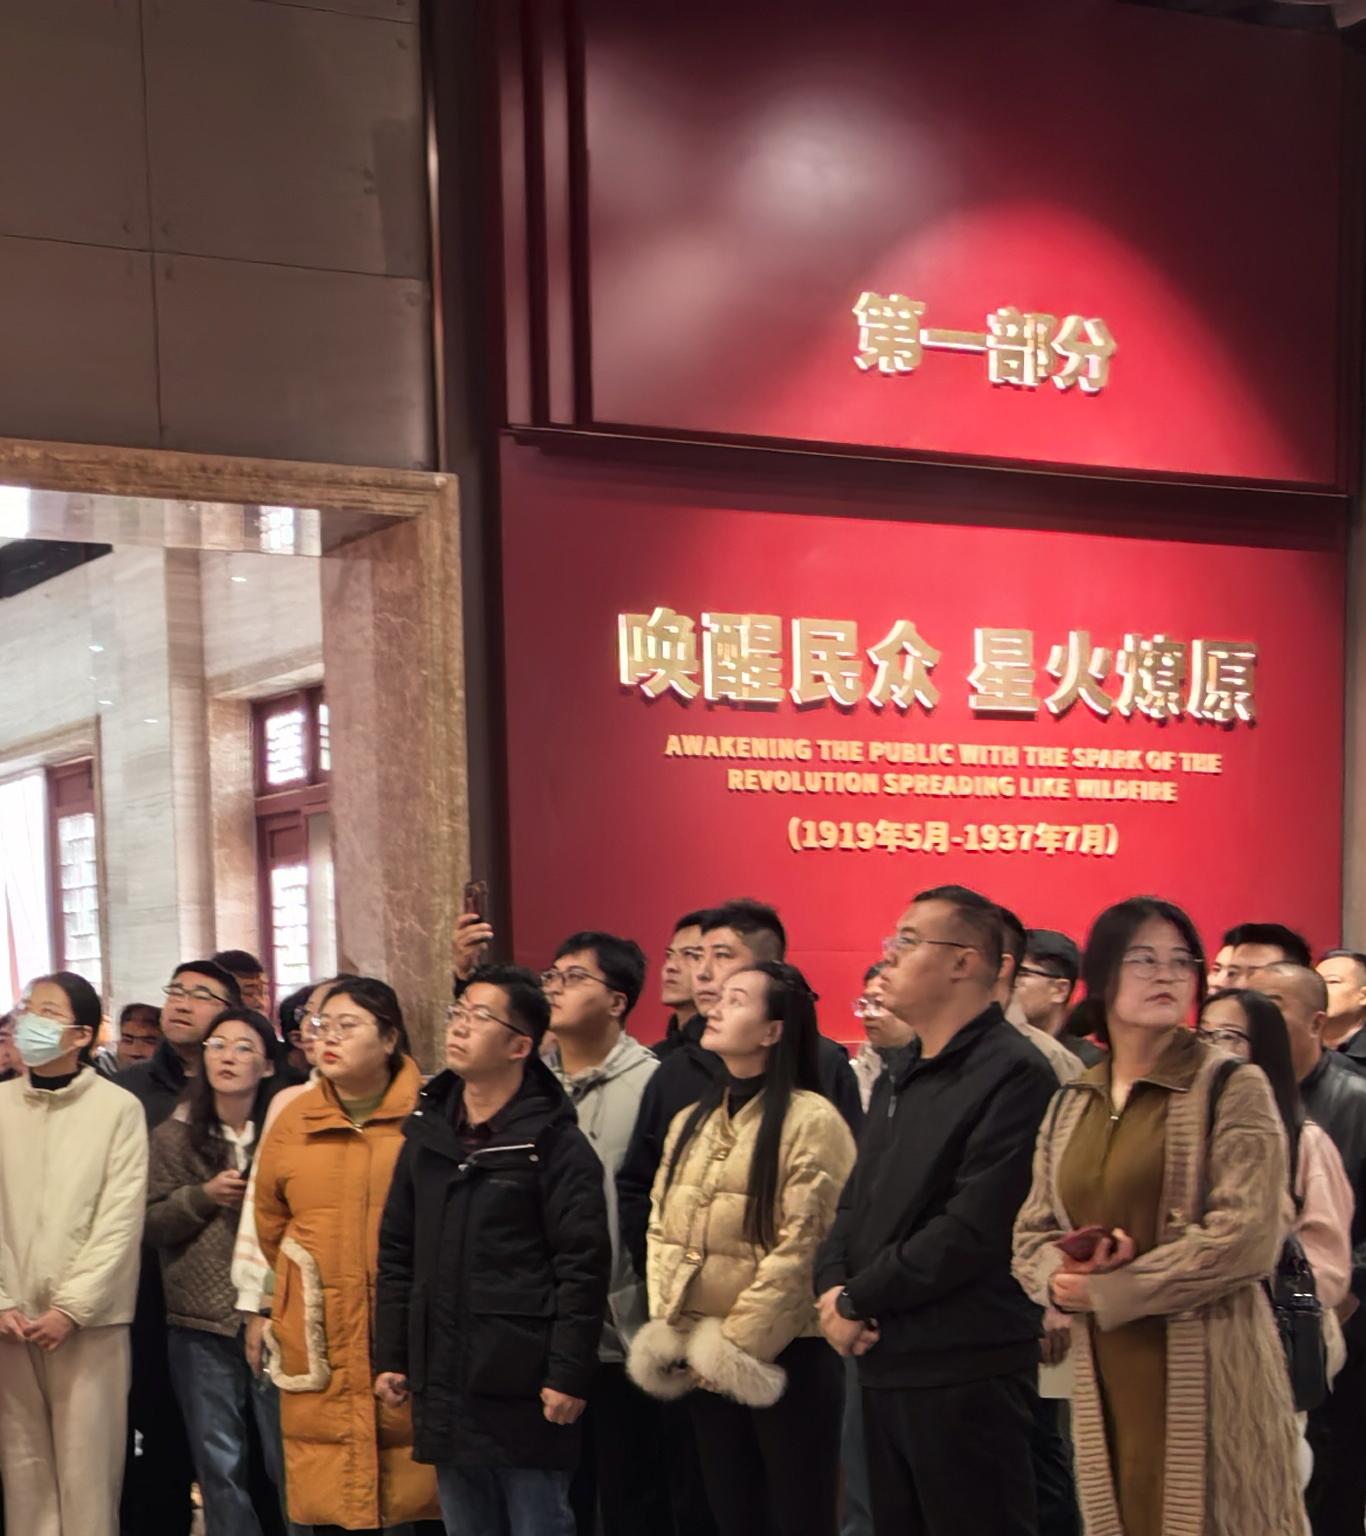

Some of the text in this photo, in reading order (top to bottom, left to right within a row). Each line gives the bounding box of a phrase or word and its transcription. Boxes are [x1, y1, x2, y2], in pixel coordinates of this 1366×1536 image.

[852, 291, 1116, 392] 第一部分
[617, 607, 1258, 727] 唤醒民众 星火燎原
[665, 735, 1222, 773] AWAKENING THE PUBLIC WITH THE SPARK OF THE
[727, 768, 1176, 801] REVOLUTION SPREADING LIKE WILDFIRE
